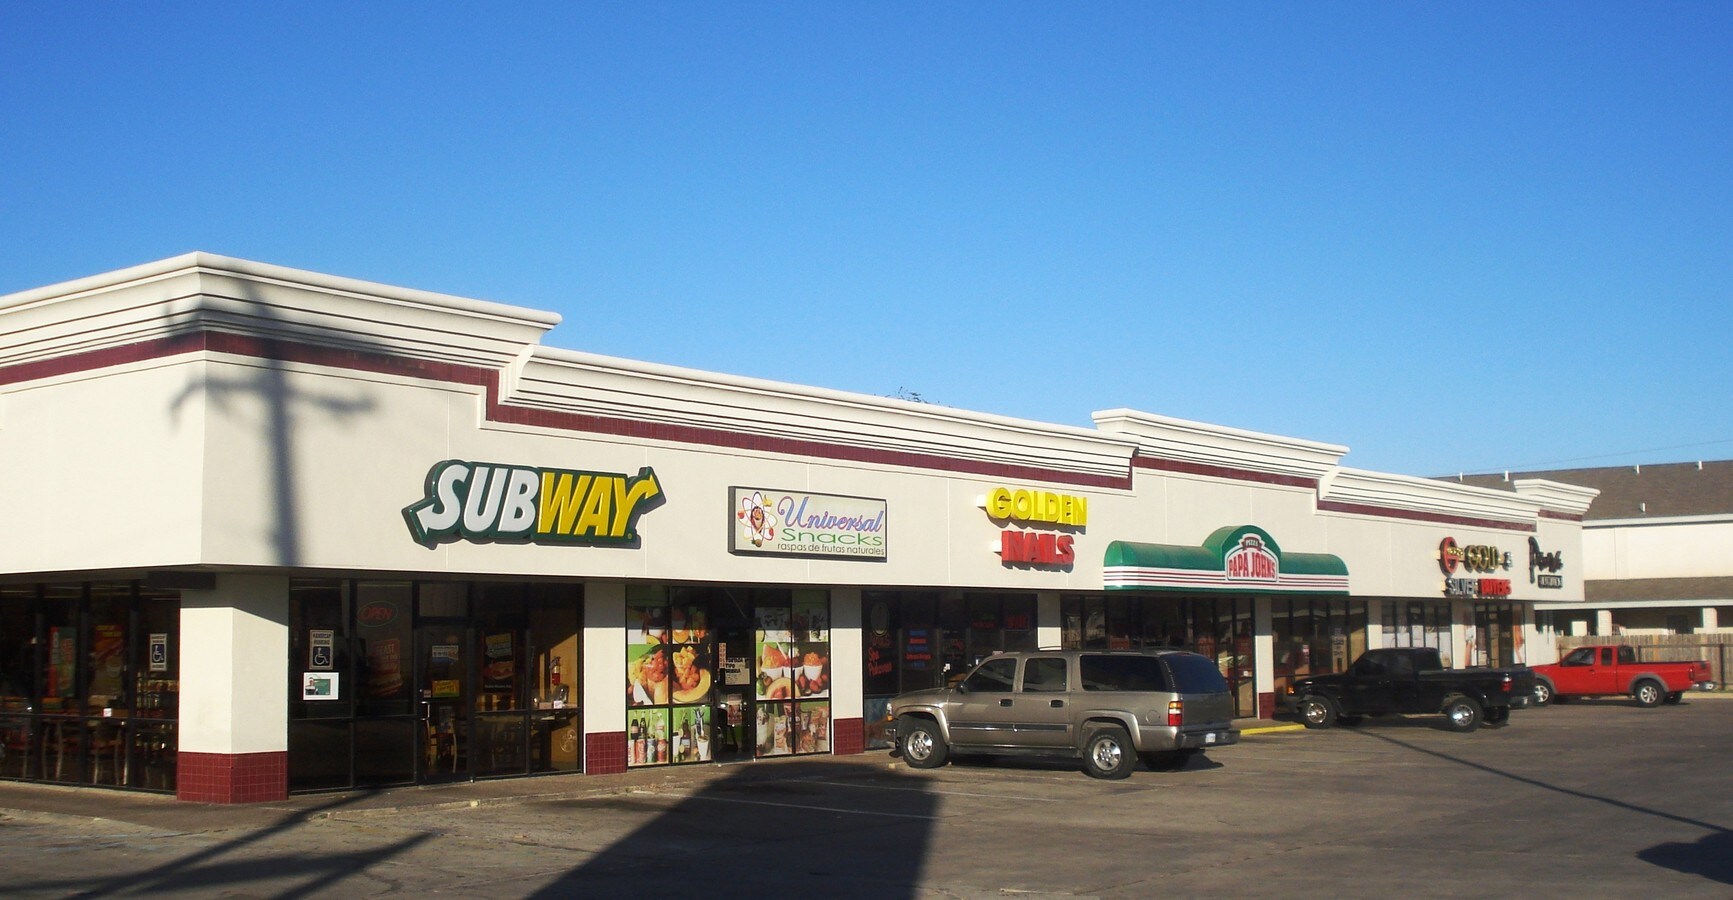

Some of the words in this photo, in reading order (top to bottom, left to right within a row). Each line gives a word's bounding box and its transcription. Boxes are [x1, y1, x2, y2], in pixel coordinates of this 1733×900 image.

[416, 464, 659, 537] SUBWAY
[986, 487, 1088, 526] GOLDEN
[777, 496, 884, 533] Universal
[777, 542, 807, 553] raspas
[807, 544, 819, 552] de
[821, 544, 845, 554] frutas
[846, 545, 885, 556] naturales
[781, 528, 883, 547] Snacks
[1002, 530, 1075, 565] NAILS
[1228, 552, 1250, 578] PAPA
[1464, 545, 1499, 571] GOLD
[1445, 577, 1477, 597] SILVER
[1478, 578, 1512, 597] BUYERS
[358, 606, 393, 621] OPEN
